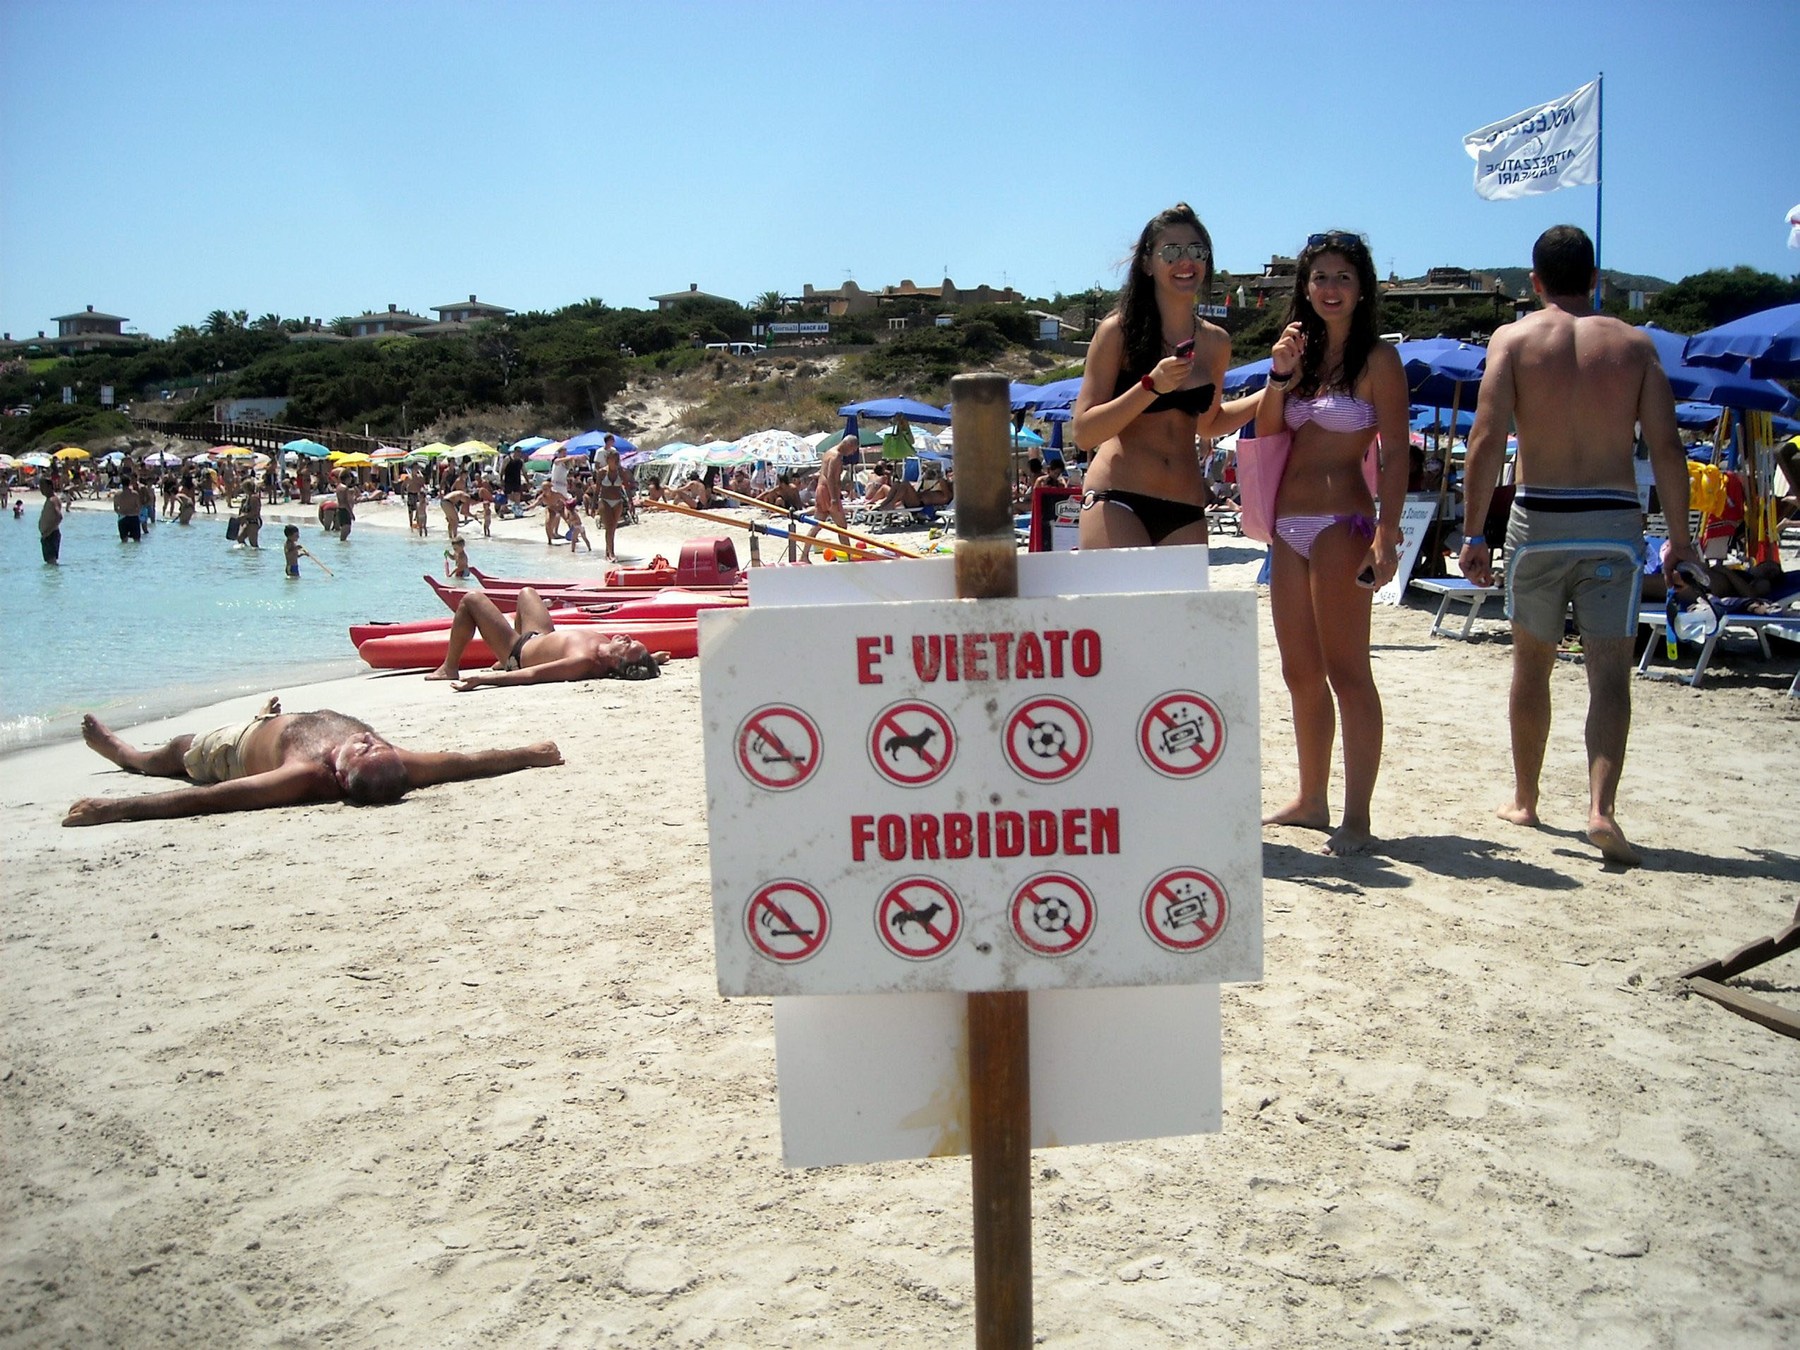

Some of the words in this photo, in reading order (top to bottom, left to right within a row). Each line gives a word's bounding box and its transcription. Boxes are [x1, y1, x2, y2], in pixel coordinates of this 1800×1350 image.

[856, 635, 894, 685] E'
[911, 628, 1103, 683] VIETATO
[850, 807, 1120, 862] FORBIDDEN
